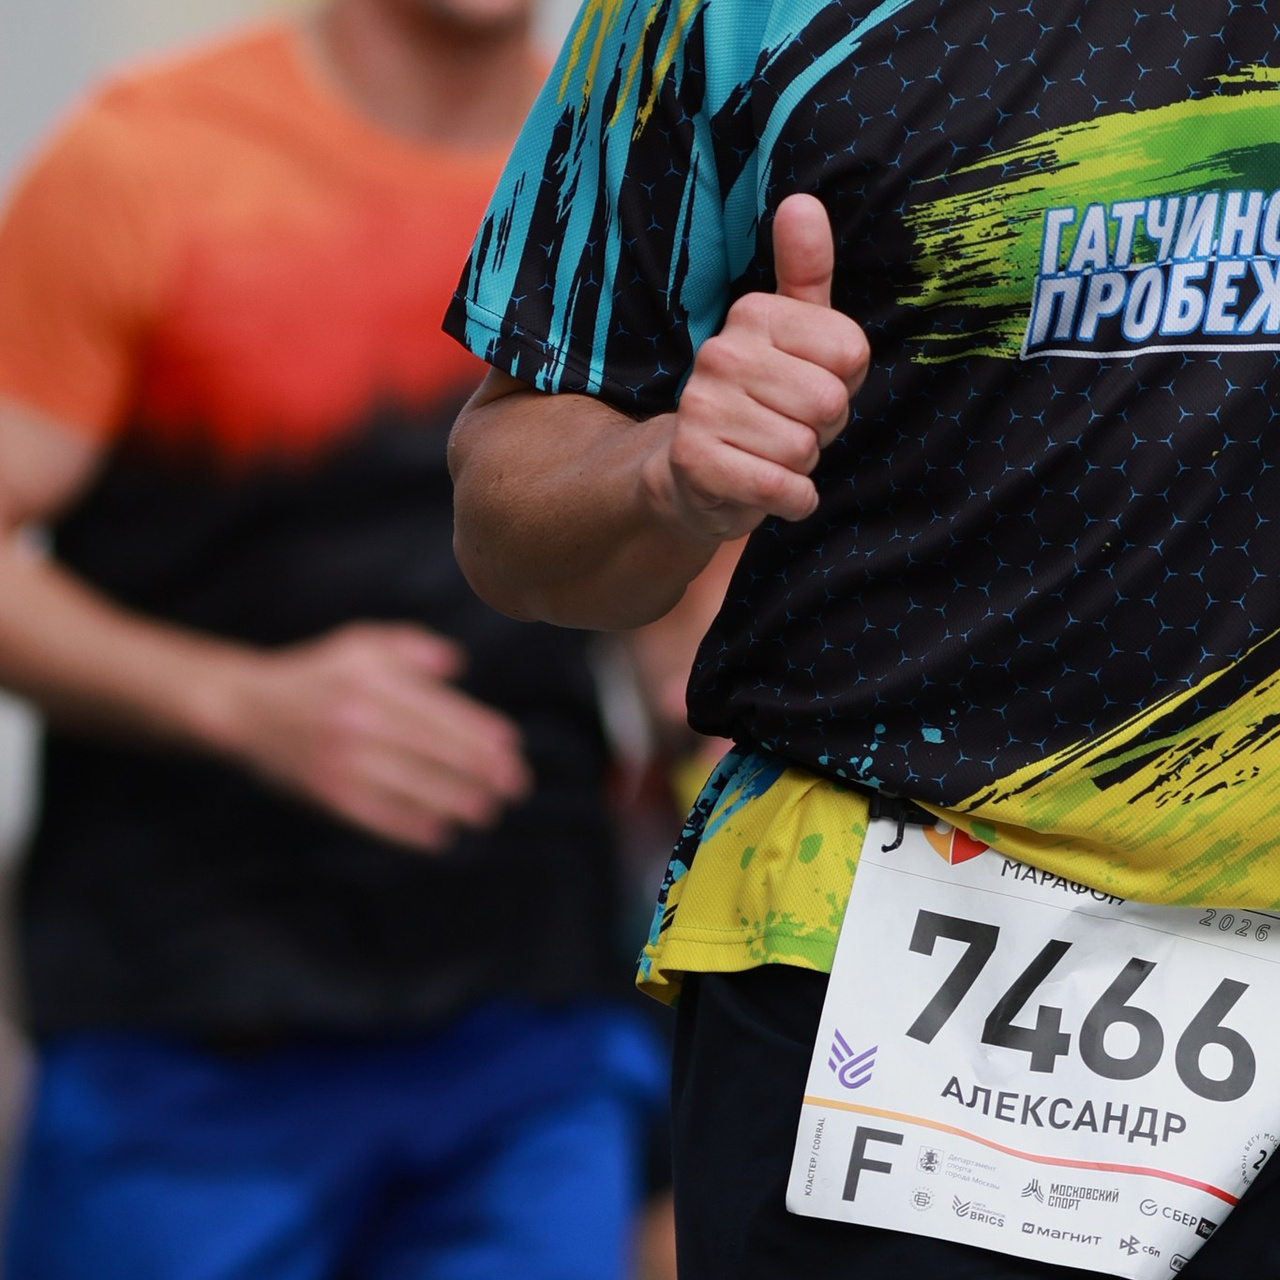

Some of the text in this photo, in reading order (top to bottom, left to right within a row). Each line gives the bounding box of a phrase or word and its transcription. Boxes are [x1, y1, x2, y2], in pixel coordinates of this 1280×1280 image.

[1199, 908, 1272, 942] 2026
[904, 909, 1257, 1102] 7466
[940, 1076, 1187, 1147] АЛЕКСАНДР
[805, 1156, 817, 1196] КЛАСТЕР
[812, 1117, 826, 1150] CORRAL
[842, 1125, 904, 1202] F
[948, 1154, 996, 1172] Департамент
[946, 1162, 972, 1174] спорта
[945, 1170, 1000, 1190] города Москвы
[1048, 1195, 1081, 1211] СПОРТ
[1050, 1183, 1119, 1203] МОСКОВСКИЙ
[970, 1211, 1005, 1228] BRICS
[1162, 1207, 1198, 1228] СБЕР
[1142, 1245, 1161, 1258] сбп
